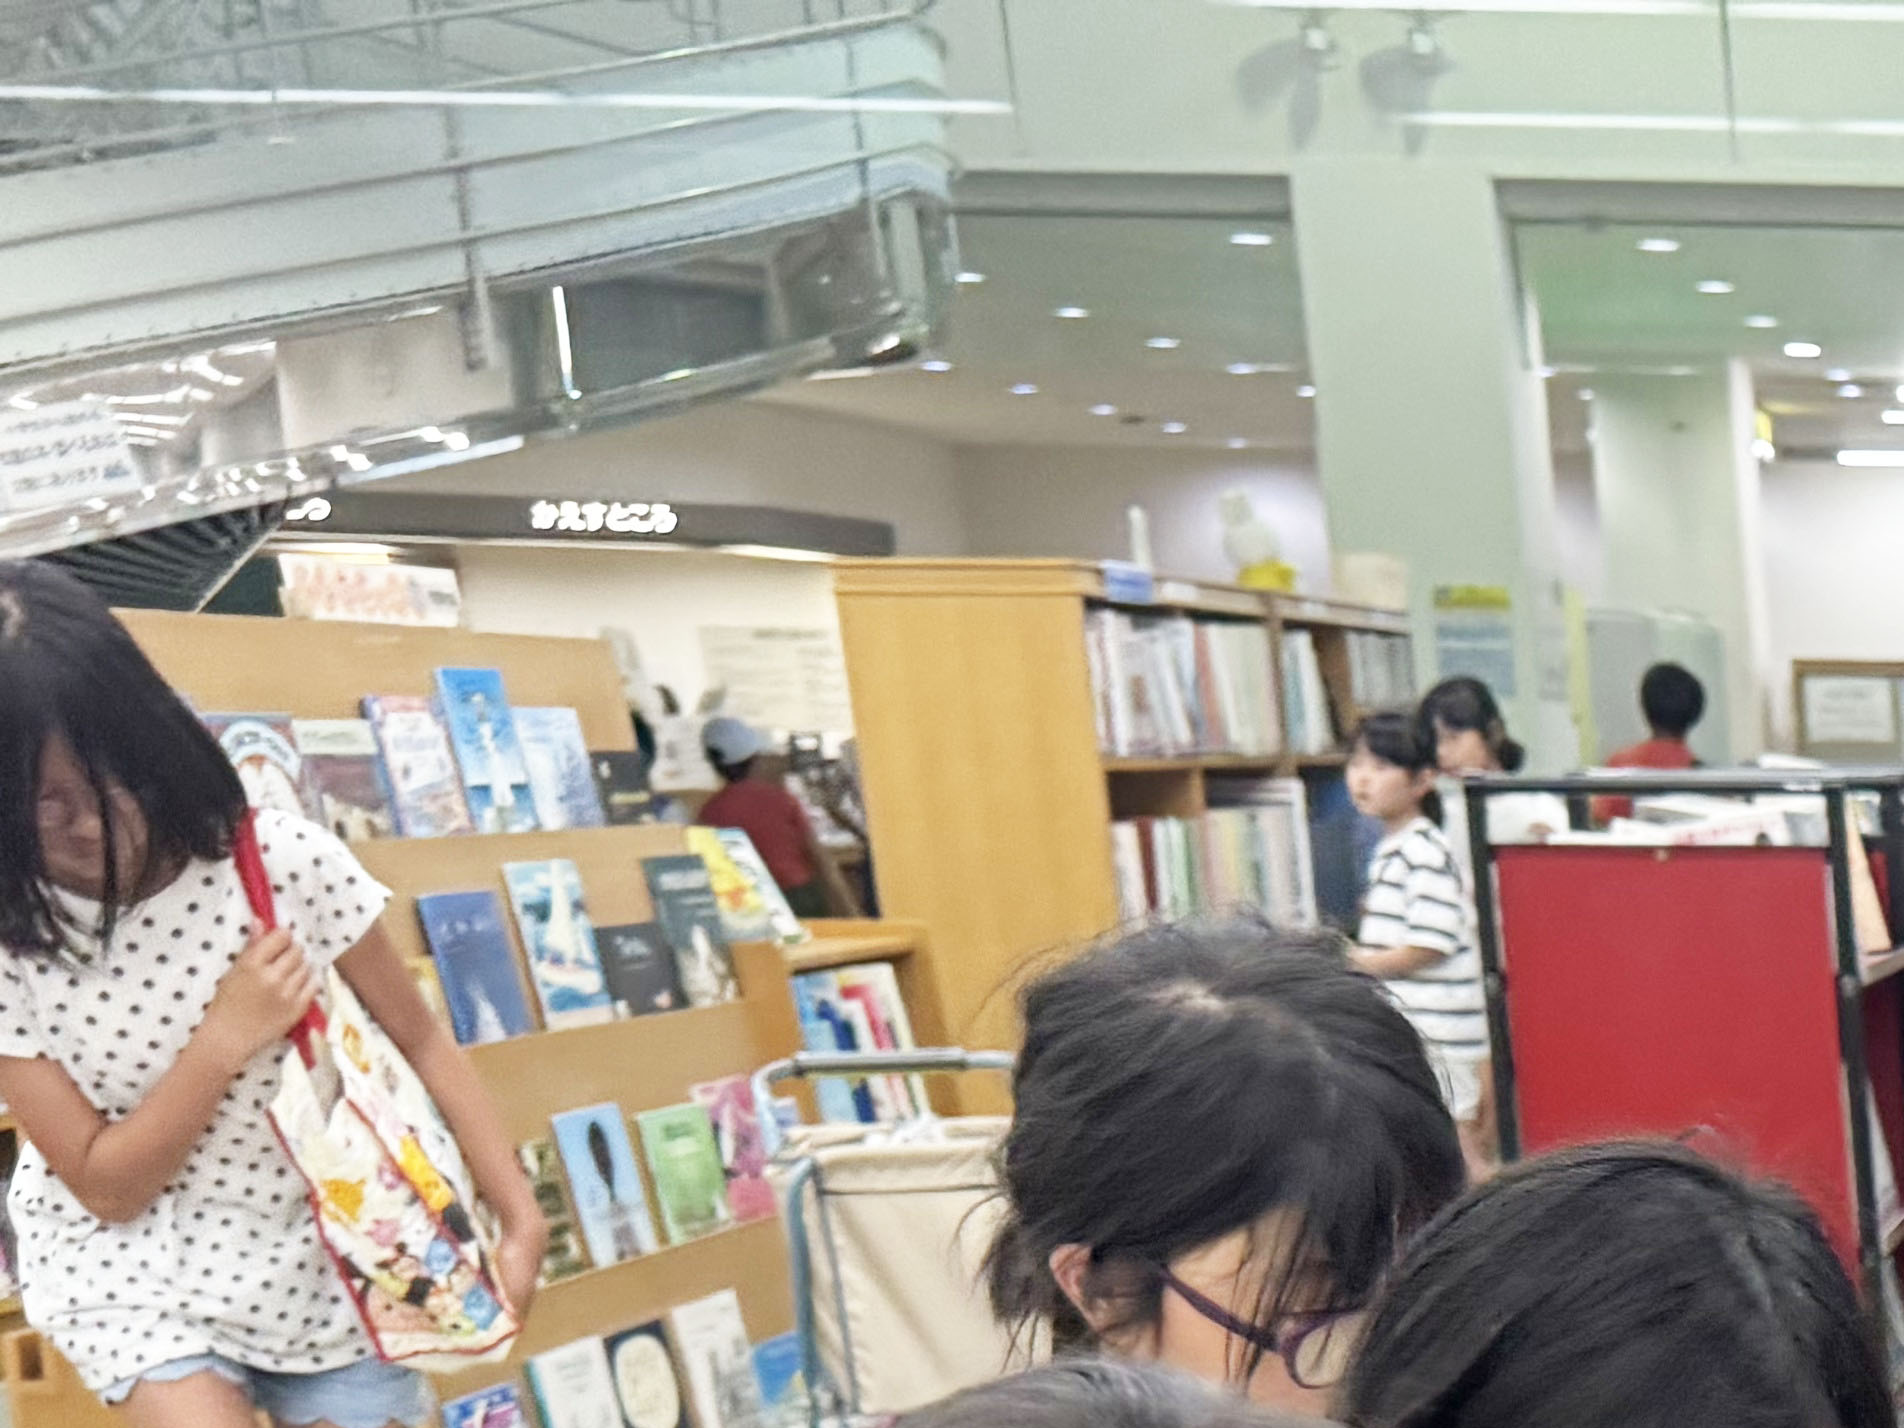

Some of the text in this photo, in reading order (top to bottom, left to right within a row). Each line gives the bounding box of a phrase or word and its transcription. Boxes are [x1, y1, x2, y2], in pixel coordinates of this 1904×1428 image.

[530, 500, 678, 534] かえすところ
